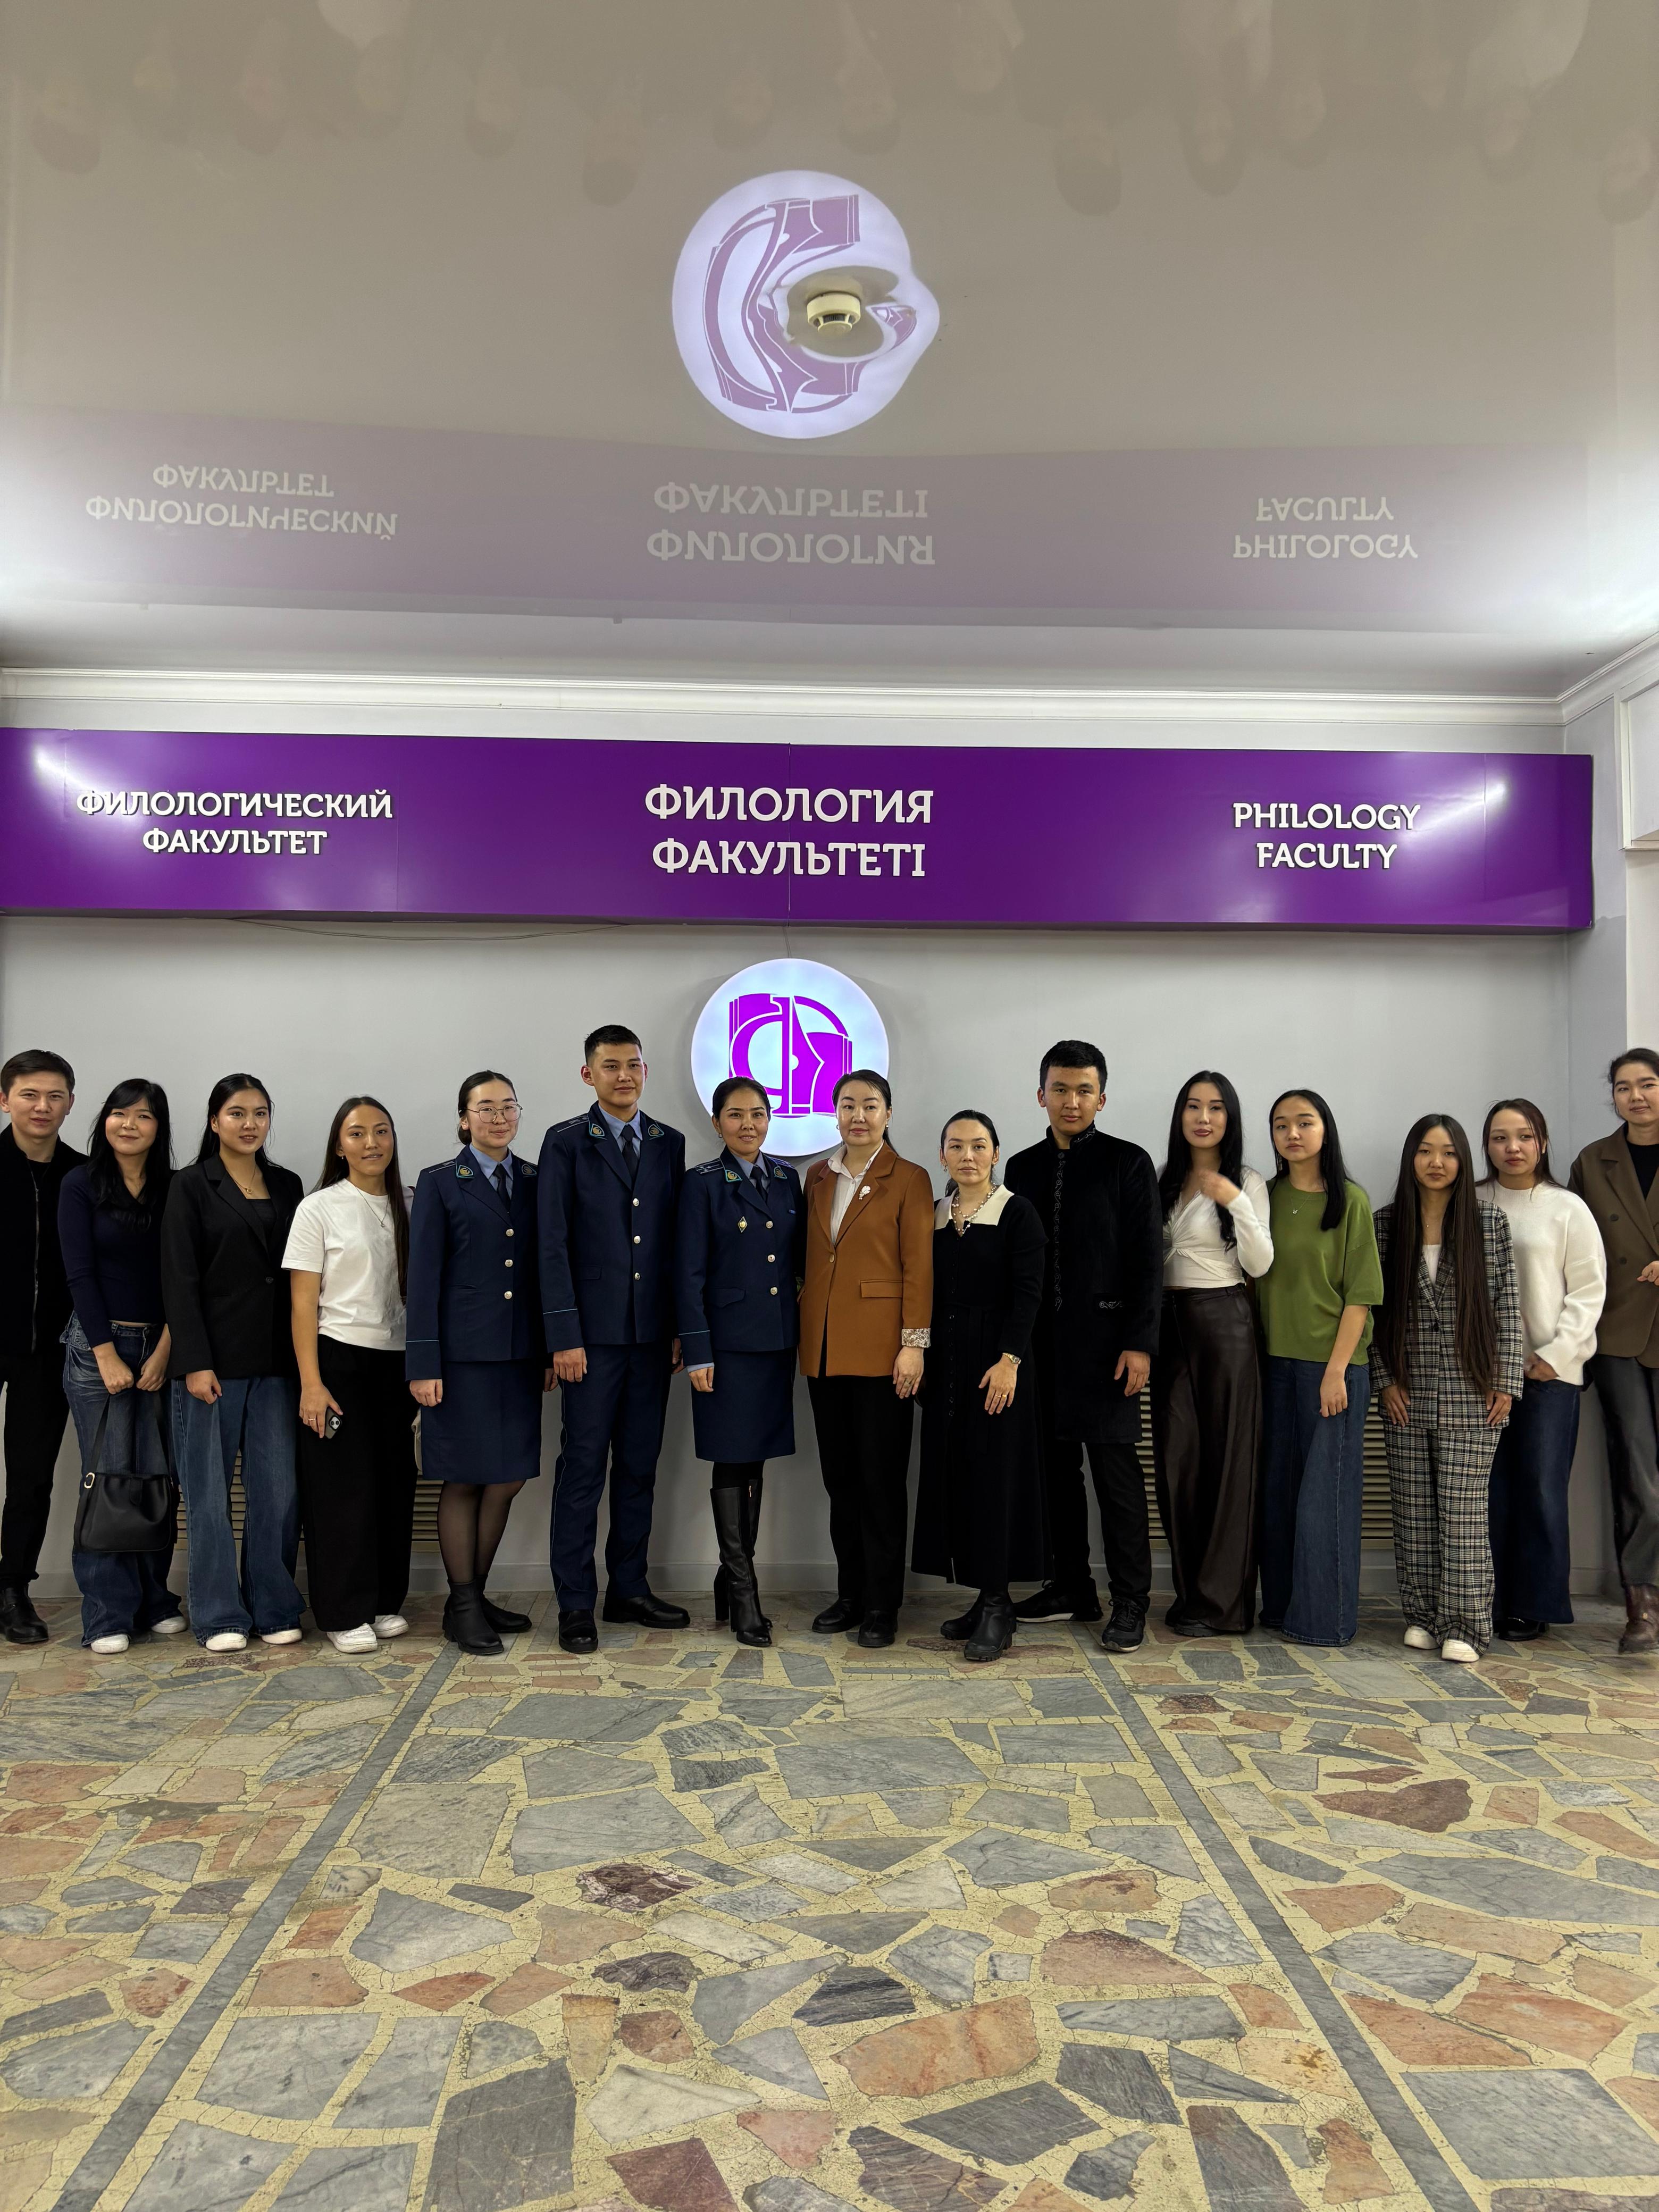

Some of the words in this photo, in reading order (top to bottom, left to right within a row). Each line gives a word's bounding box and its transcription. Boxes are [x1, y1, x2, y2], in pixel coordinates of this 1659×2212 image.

[76, 789, 393, 819] ФИЛОЛОГИЧЕСКИЙ
[645, 783, 934, 824] ФИЛОЛОГИЯ
[1233, 802, 1421, 831] PHILOLOGY
[143, 828, 328, 855] ФАКУЛЬТЕТ
[1256, 842, 1398, 869] FACULTY
[652, 837, 926, 877] ФАКУЛЬТЕТІ
